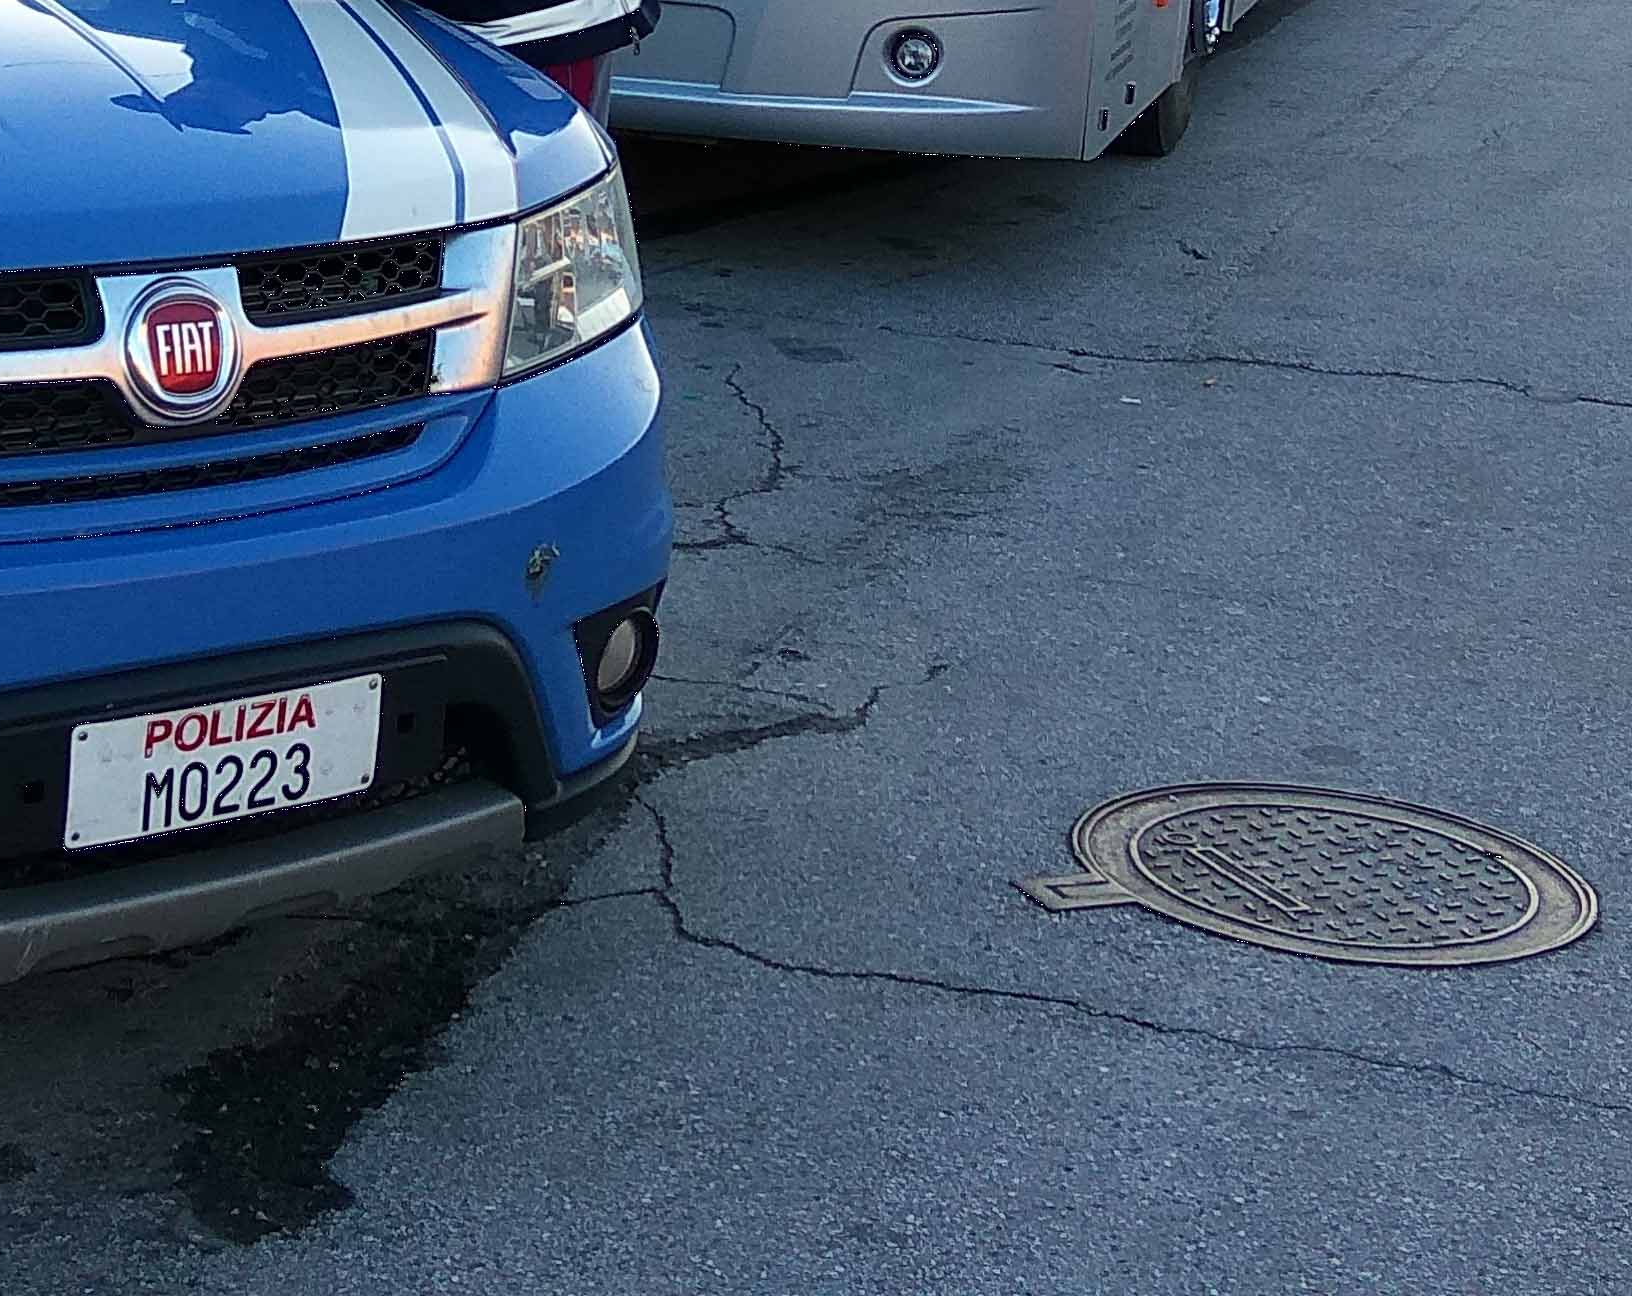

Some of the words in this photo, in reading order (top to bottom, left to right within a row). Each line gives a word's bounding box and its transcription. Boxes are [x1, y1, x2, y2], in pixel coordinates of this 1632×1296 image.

[156, 321, 214, 376] FIAT
[144, 693, 317, 759] POLIZIA
[141, 742, 311, 832] M0223
